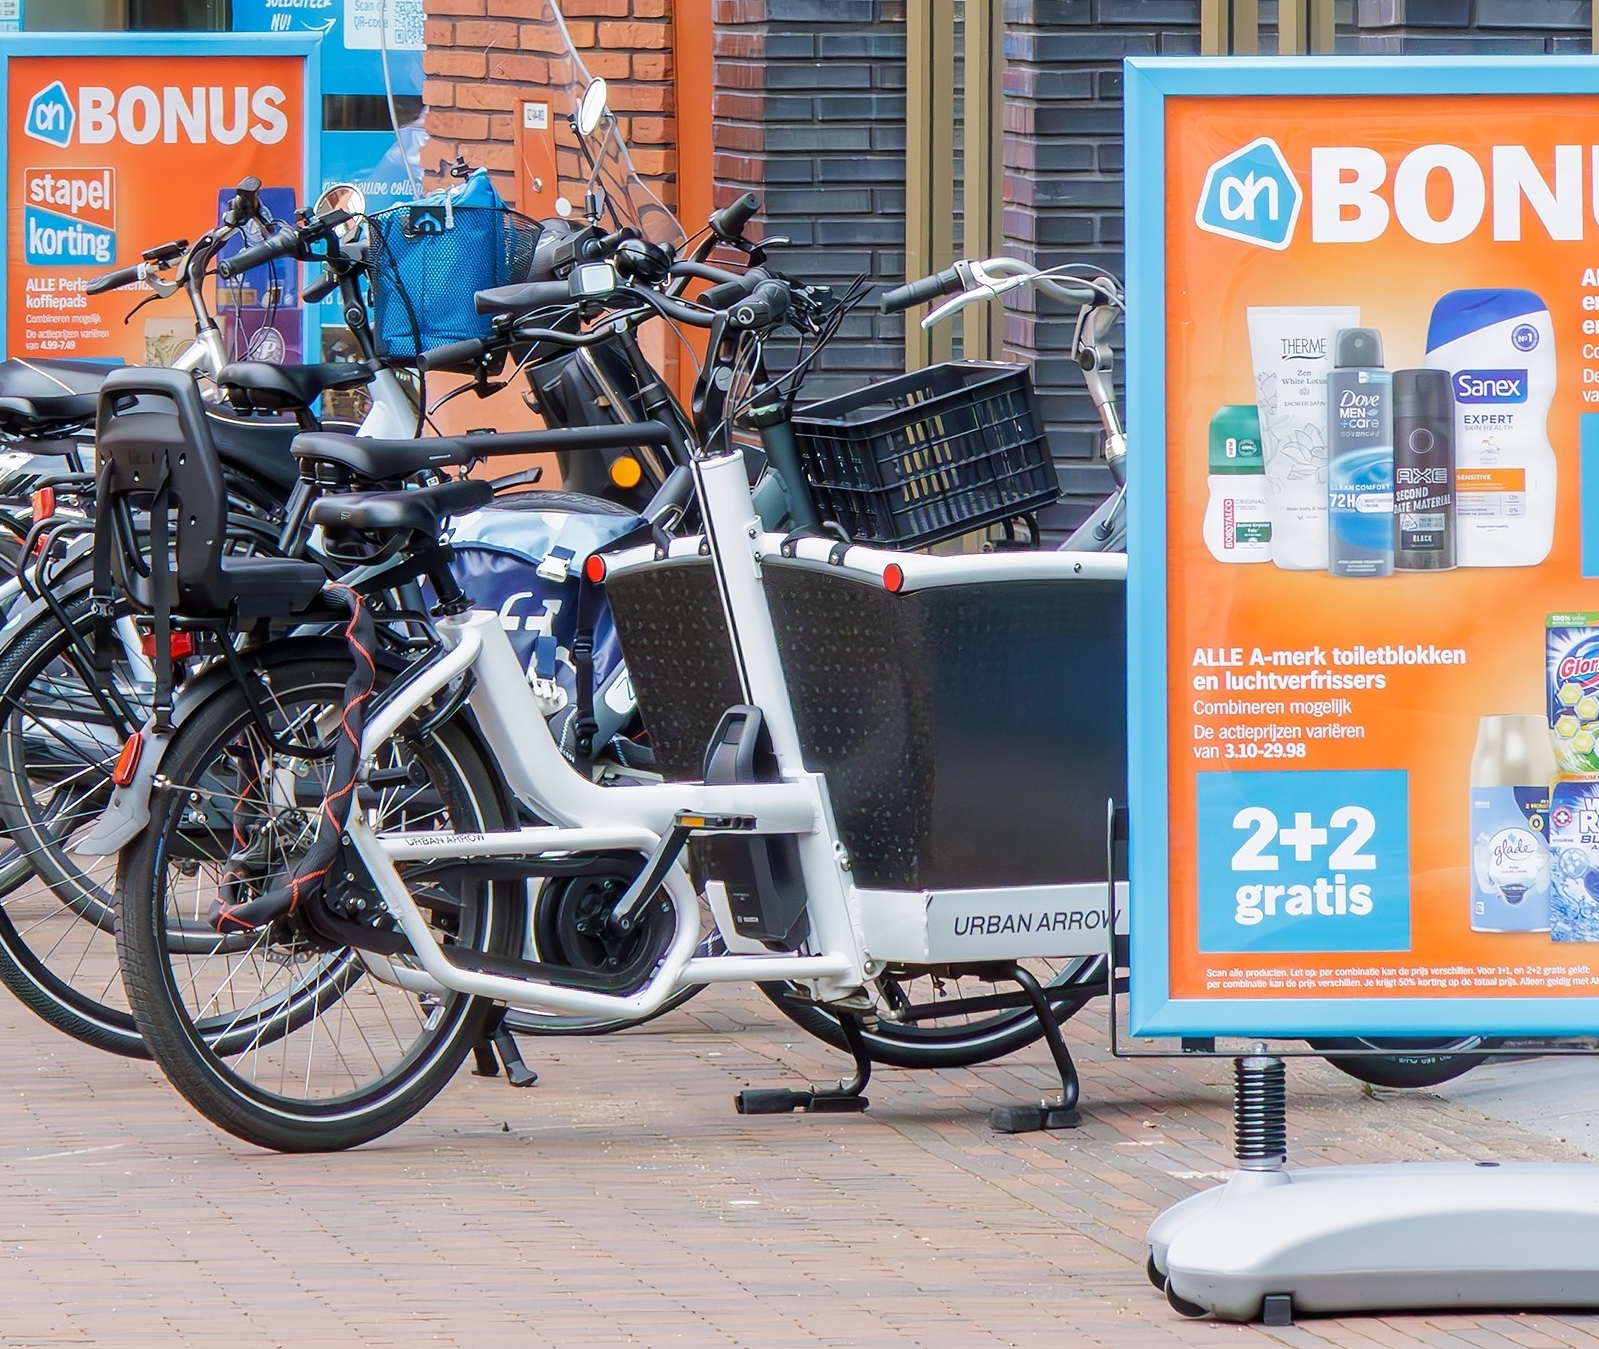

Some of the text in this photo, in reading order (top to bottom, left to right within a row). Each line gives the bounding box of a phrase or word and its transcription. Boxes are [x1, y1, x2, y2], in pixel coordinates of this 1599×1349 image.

[271, 14, 292, 30] NU!
[79, 86, 288, 145] BONUS
[30, 170, 110, 213] stapel
[30, 217, 110, 262] korting
[26, 278, 55, 291] ALLE
[26, 294, 87, 310] koffiepads
[1281, 338, 1326, 354] THERME
[1459, 374, 1521, 398] Sanex
[1339, 389, 1380, 407] Dove
[1340, 408, 1365, 418] MEN
[1464, 414, 1514, 424] EXPERT
[1396, 468, 1447, 484] AXE
[1192, 645, 1466, 666] ALLE A-merk toiletblokken
[1193, 670, 1386, 690] en luchtverfrissers
[1194, 698, 1352, 717] Combineren mogelijk
[1194, 743, 1306, 758] van 3.10-29.98
[405, 837, 444, 846] URBAN
[1231, 806, 1377, 873] 2+2
[1494, 835, 1534, 866] glade
[1234, 874, 1374, 926] gratis
[954, 909, 1122, 937] URBAN ARROW
